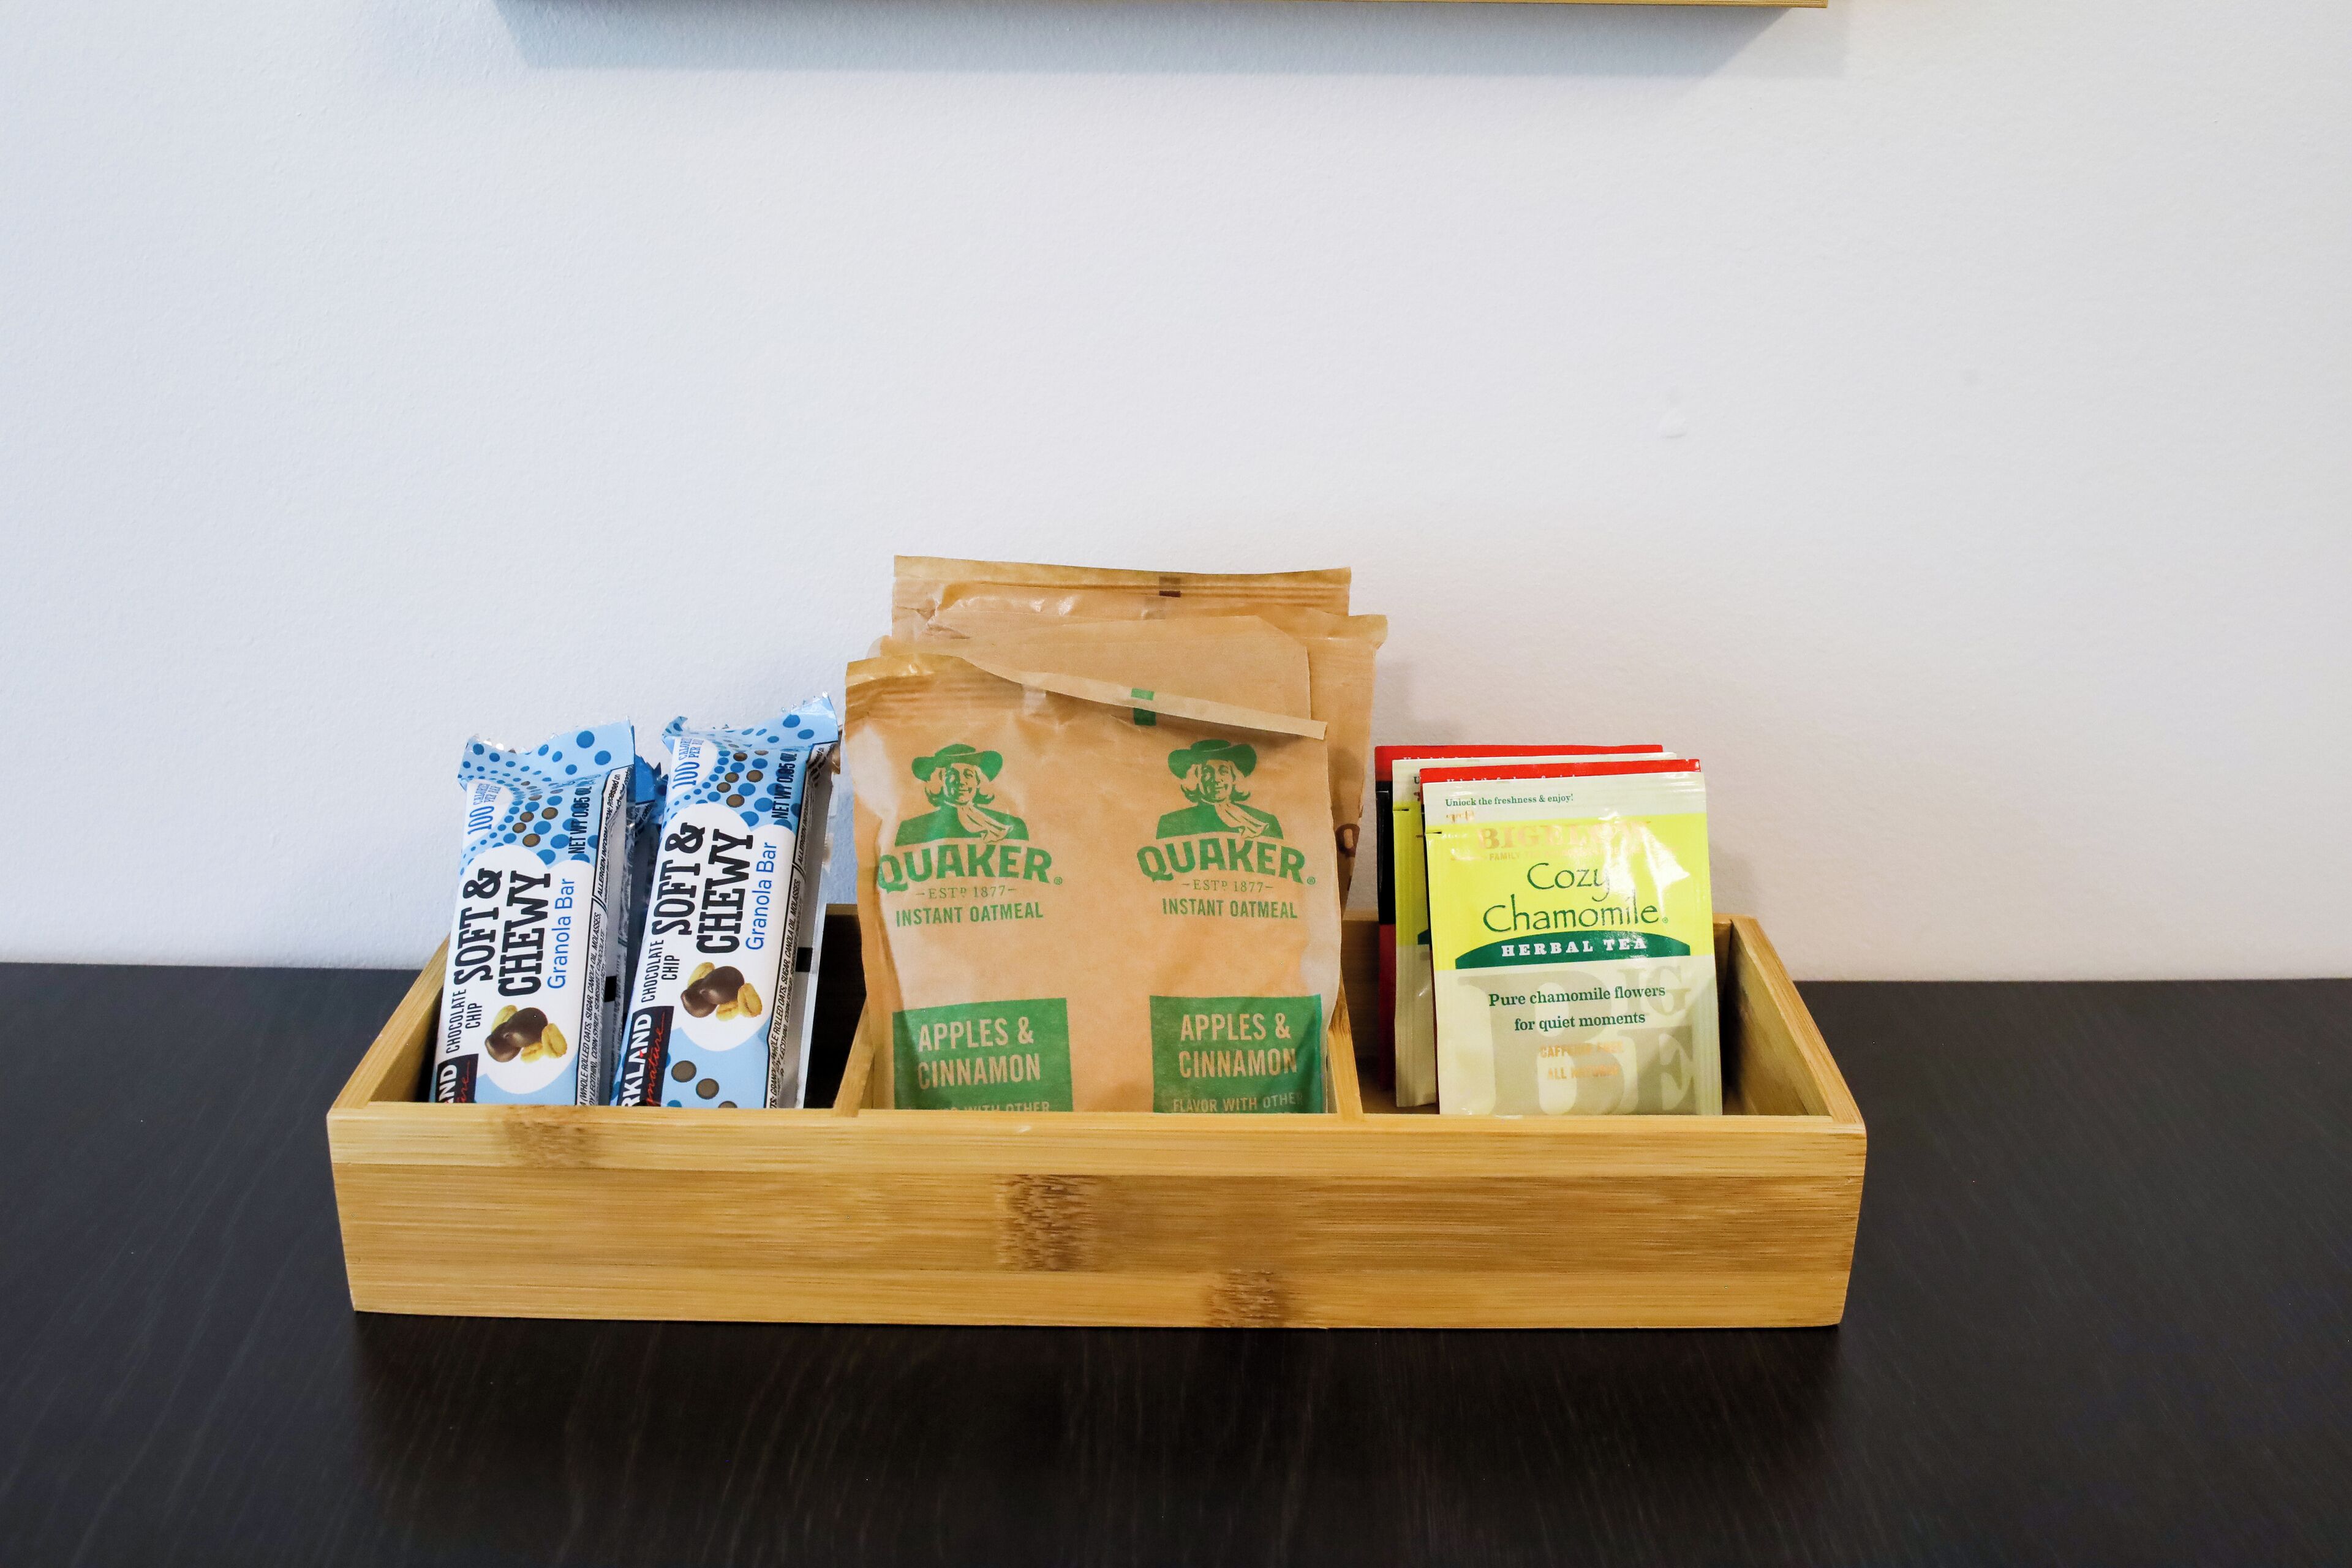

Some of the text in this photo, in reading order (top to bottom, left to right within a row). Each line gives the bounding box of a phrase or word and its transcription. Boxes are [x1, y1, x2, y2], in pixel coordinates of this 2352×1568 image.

[671, 761, 700, 790] 100
[776, 761, 796, 783] 0.85
[774, 784, 792, 802] WT
[1445, 798, 1477, 807] Unlock
[1479, 797, 1492, 805] the
[1494, 795, 1537, 805] freshness
[1548, 793, 1574, 803] enjoy!
[467, 805, 495, 835] 100
[572, 797, 590, 819] 0.85
[771, 801, 789, 819] NET
[571, 820, 587, 837] WT
[568, 837, 586, 854] NET
[1489, 852, 1520, 862] FAMILY
[878, 843, 1052, 894] QUAKER
[1136, 837, 1305, 884] QUAKER
[651, 822, 706, 936] SOFT &
[696, 829, 754, 954] CHEWY
[974, 884, 1006, 898] 1877
[1234, 881, 1265, 893] 1877
[1527, 862, 1610, 903] Cozy
[745, 842, 777, 951] Granola Bar
[1162, 897, 1298, 919] INSTANT OATMEAL
[1482, 889, 1659, 933] Chamomile
[453, 867, 502, 986] SOFT &
[895, 901, 1044, 927] INSTANT OATMEAL
[497, 870, 551, 997] CHEWY
[547, 878, 575, 989] Granola Bar
[1501, 937, 1648, 957] HERBAL TEA
[641, 940, 665, 1003] CHOCOLATE
[661, 955, 680, 981] CHIP
[1488, 985, 1666, 1007] Pure chamomile flowers
[445, 989, 467, 1054] CHOCOLATE
[466, 1002, 483, 1029] CHIP
[1180, 1012, 1292, 1042] APPLES &
[1514, 1012, 1646, 1033] for quiet moments
[919, 1016, 1035, 1052] APPLES &
[582, 1043, 590, 1072] ROLLED
[918, 1053, 1041, 1090] CINNAMON
[1178, 1048, 1298, 1079] CINNAMON
[1172, 1098, 1218, 1112] FLAVOR
[1223, 1098, 1257, 1112] WITH
